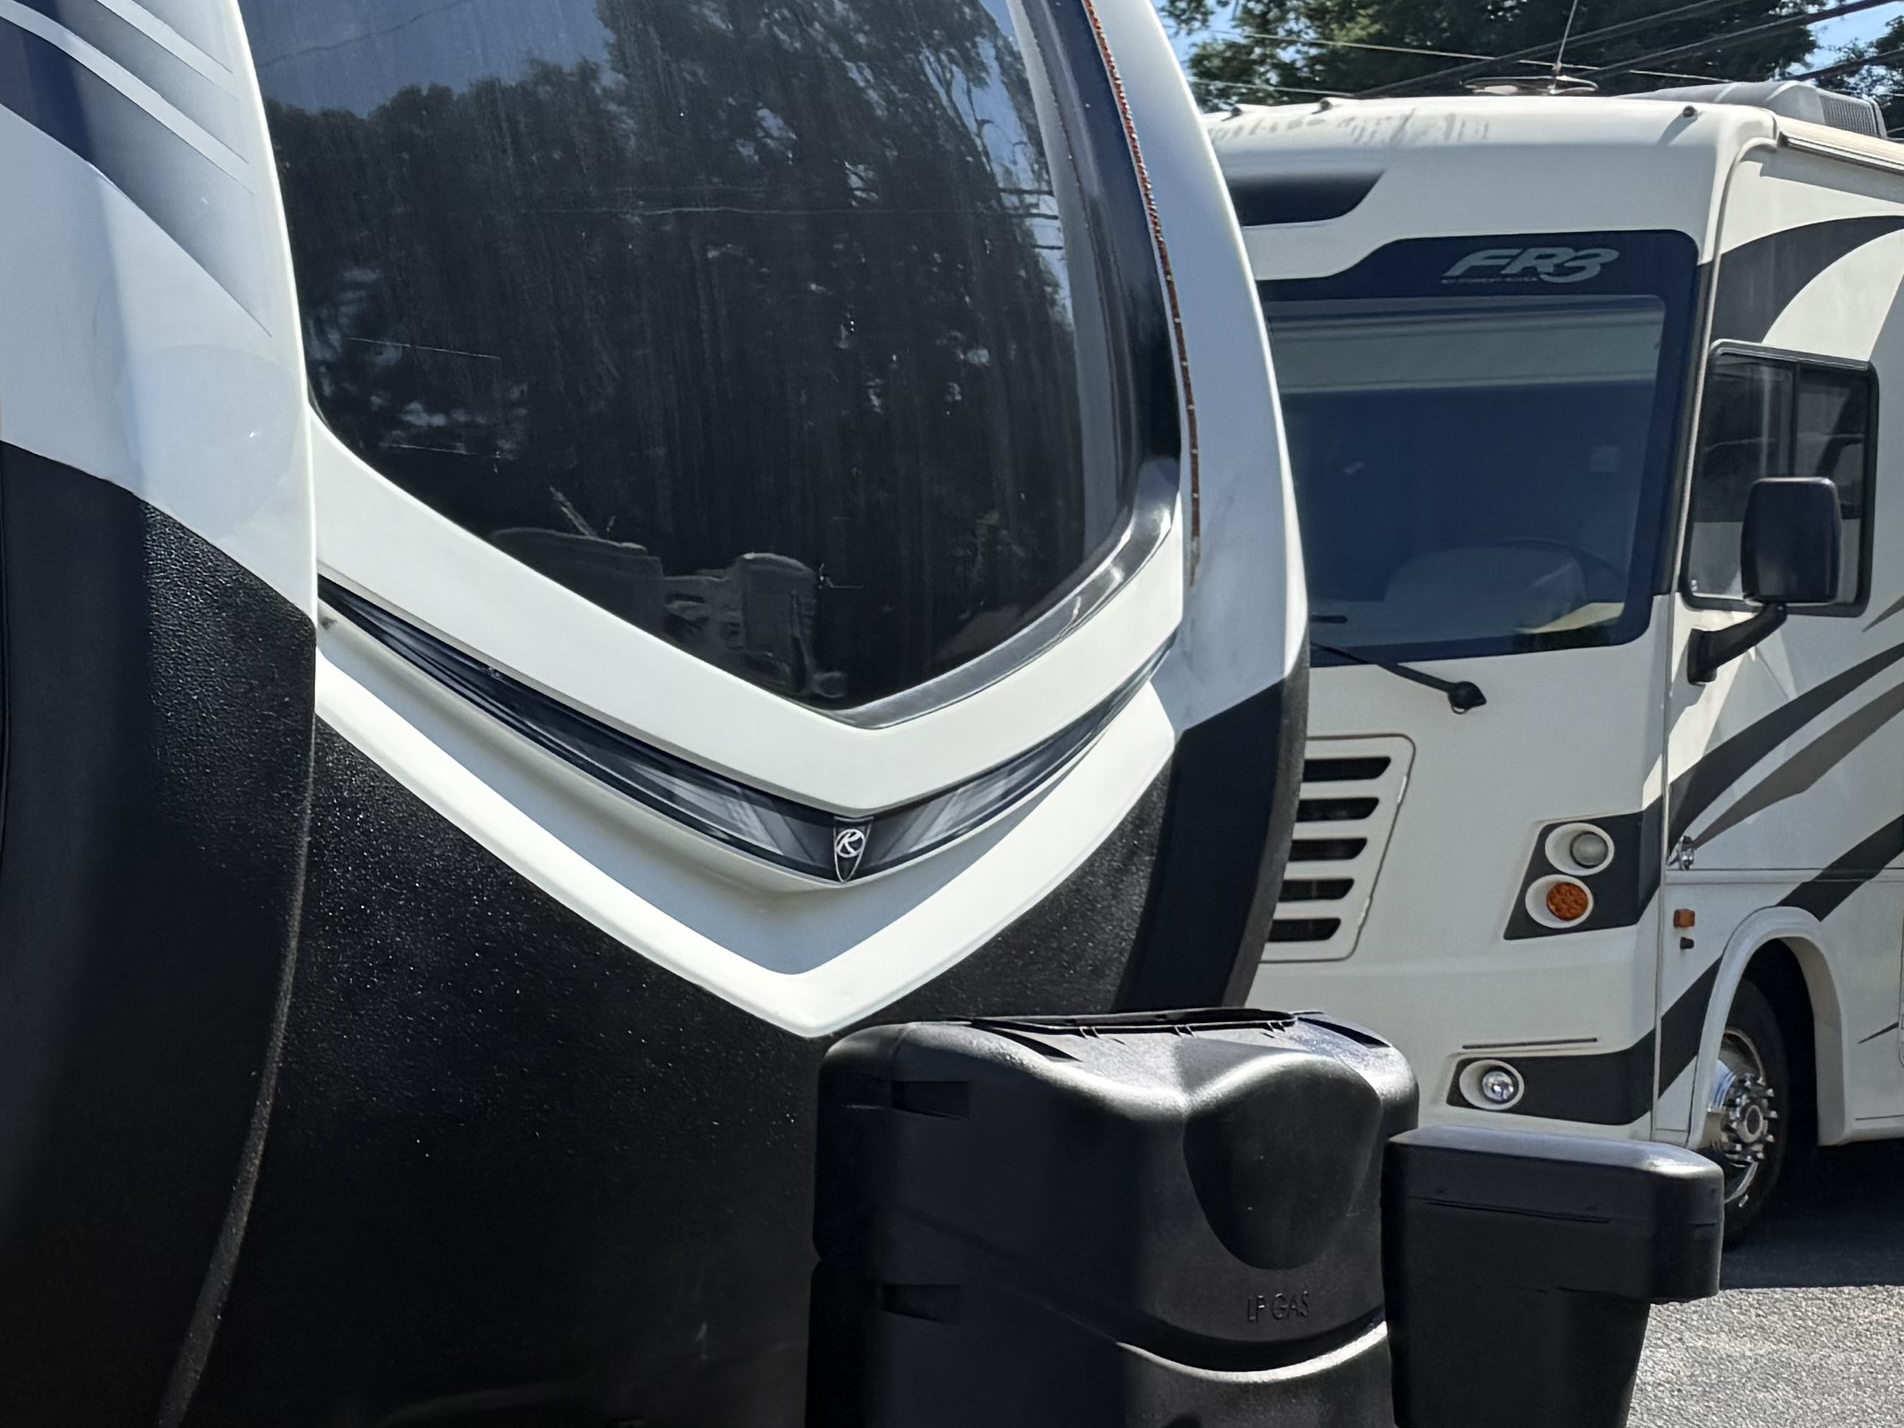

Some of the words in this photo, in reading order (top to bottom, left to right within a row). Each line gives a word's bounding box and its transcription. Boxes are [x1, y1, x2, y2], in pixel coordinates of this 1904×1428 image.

[1441, 247, 1619, 283] FR3
[1248, 1295, 1265, 1323] LP
[1271, 1290, 1310, 1320] GAS
